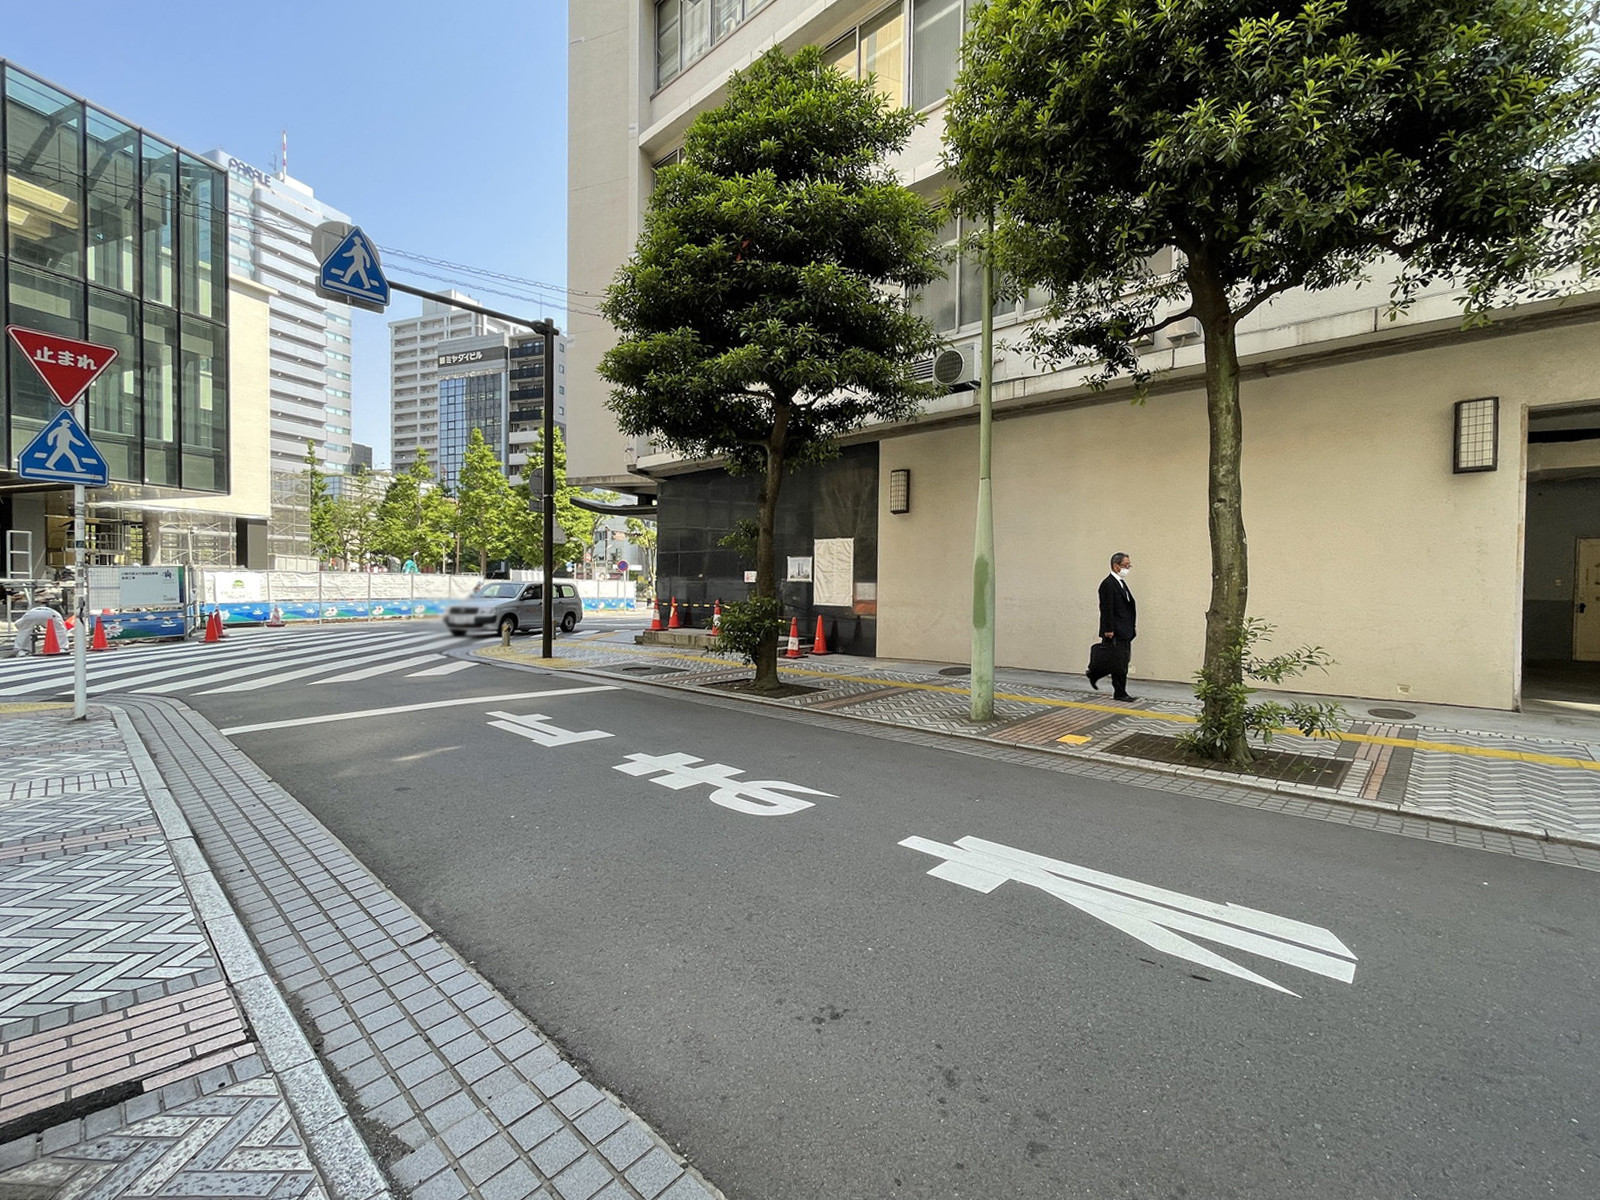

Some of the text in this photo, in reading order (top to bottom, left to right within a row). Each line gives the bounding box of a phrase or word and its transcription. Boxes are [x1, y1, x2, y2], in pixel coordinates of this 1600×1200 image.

[33, 346, 98, 370] 止まれ
[485, 711, 1358, 998] 止まれ
